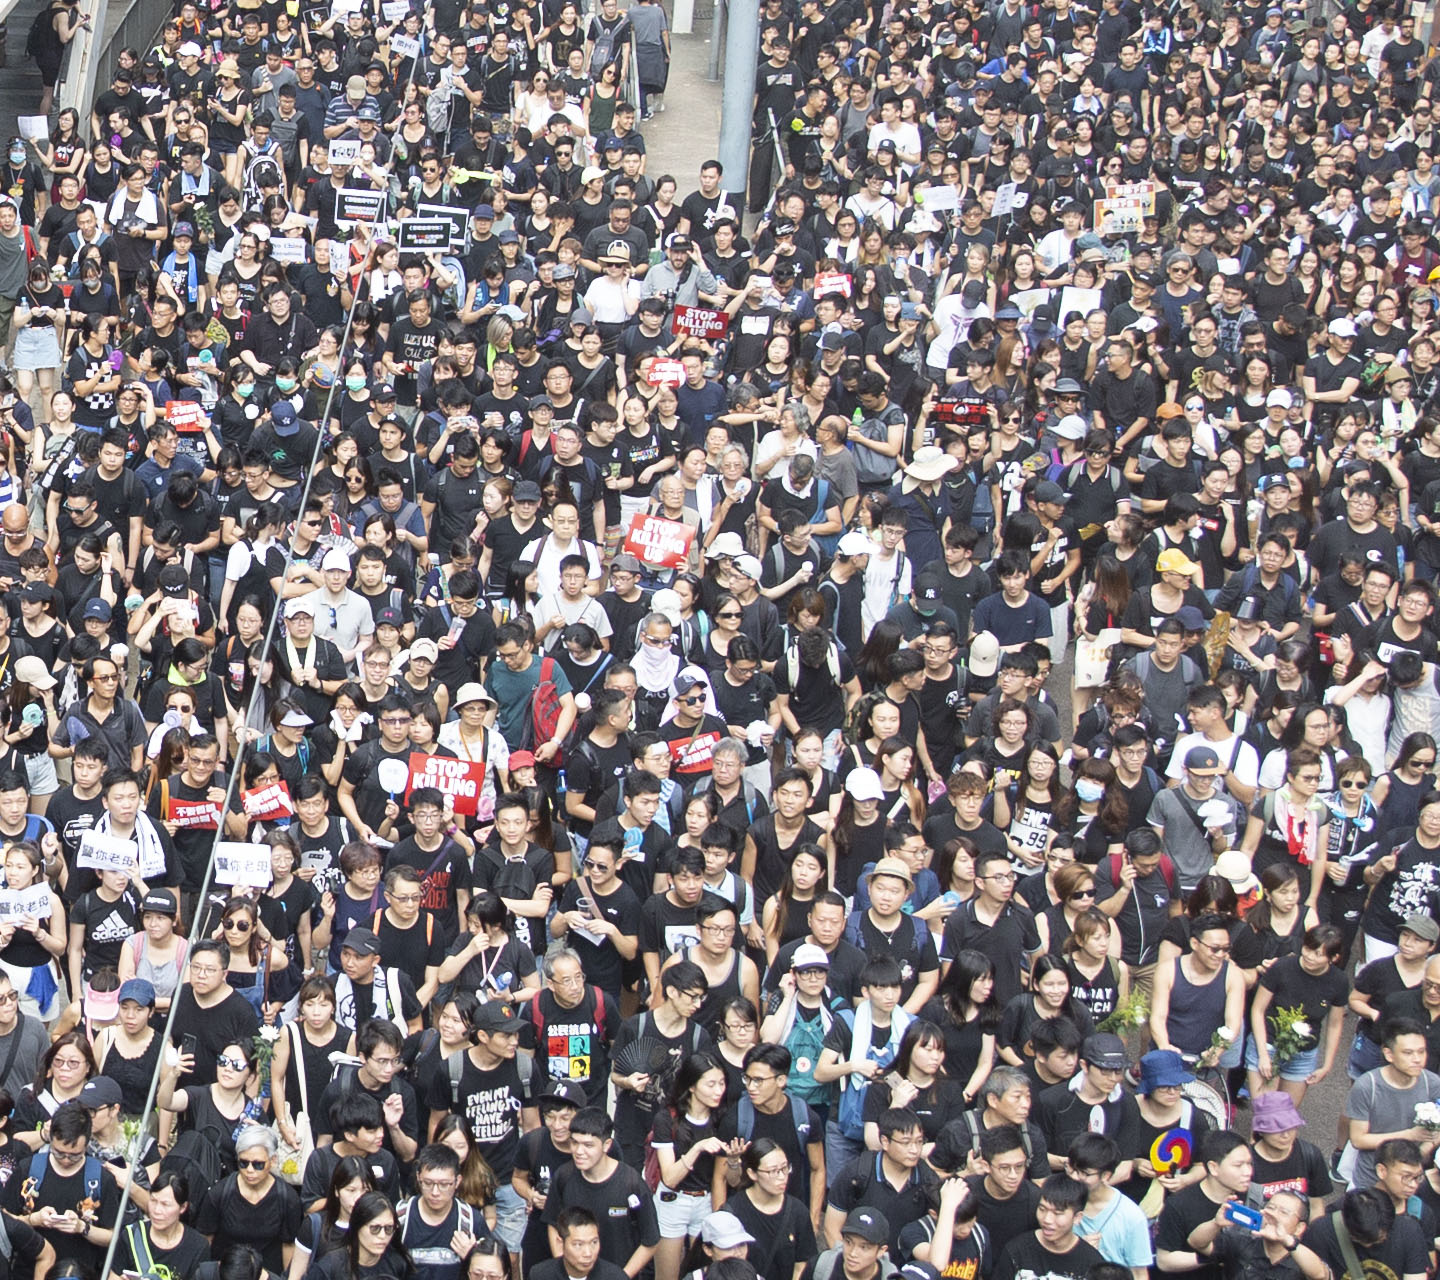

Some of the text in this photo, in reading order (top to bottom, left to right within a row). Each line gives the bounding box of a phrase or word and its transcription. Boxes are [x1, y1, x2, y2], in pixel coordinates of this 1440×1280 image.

[685, 307, 718, 321] STOP
[676, 315, 724, 331] KILLING
[690, 325, 707, 337] US
[641, 517, 682, 538] STOP
[630, 529, 686, 555] KILLING
[643, 547, 666, 563] US
[424, 757, 471, 779] STOP
[411, 773, 477, 797] KILLING
[92, 926, 135, 941] adidas
[467, 1085, 510, 1106] EVEN MY
[466, 1100, 511, 1119] FEELINGS
[475, 1111, 503, 1127] HAVE
